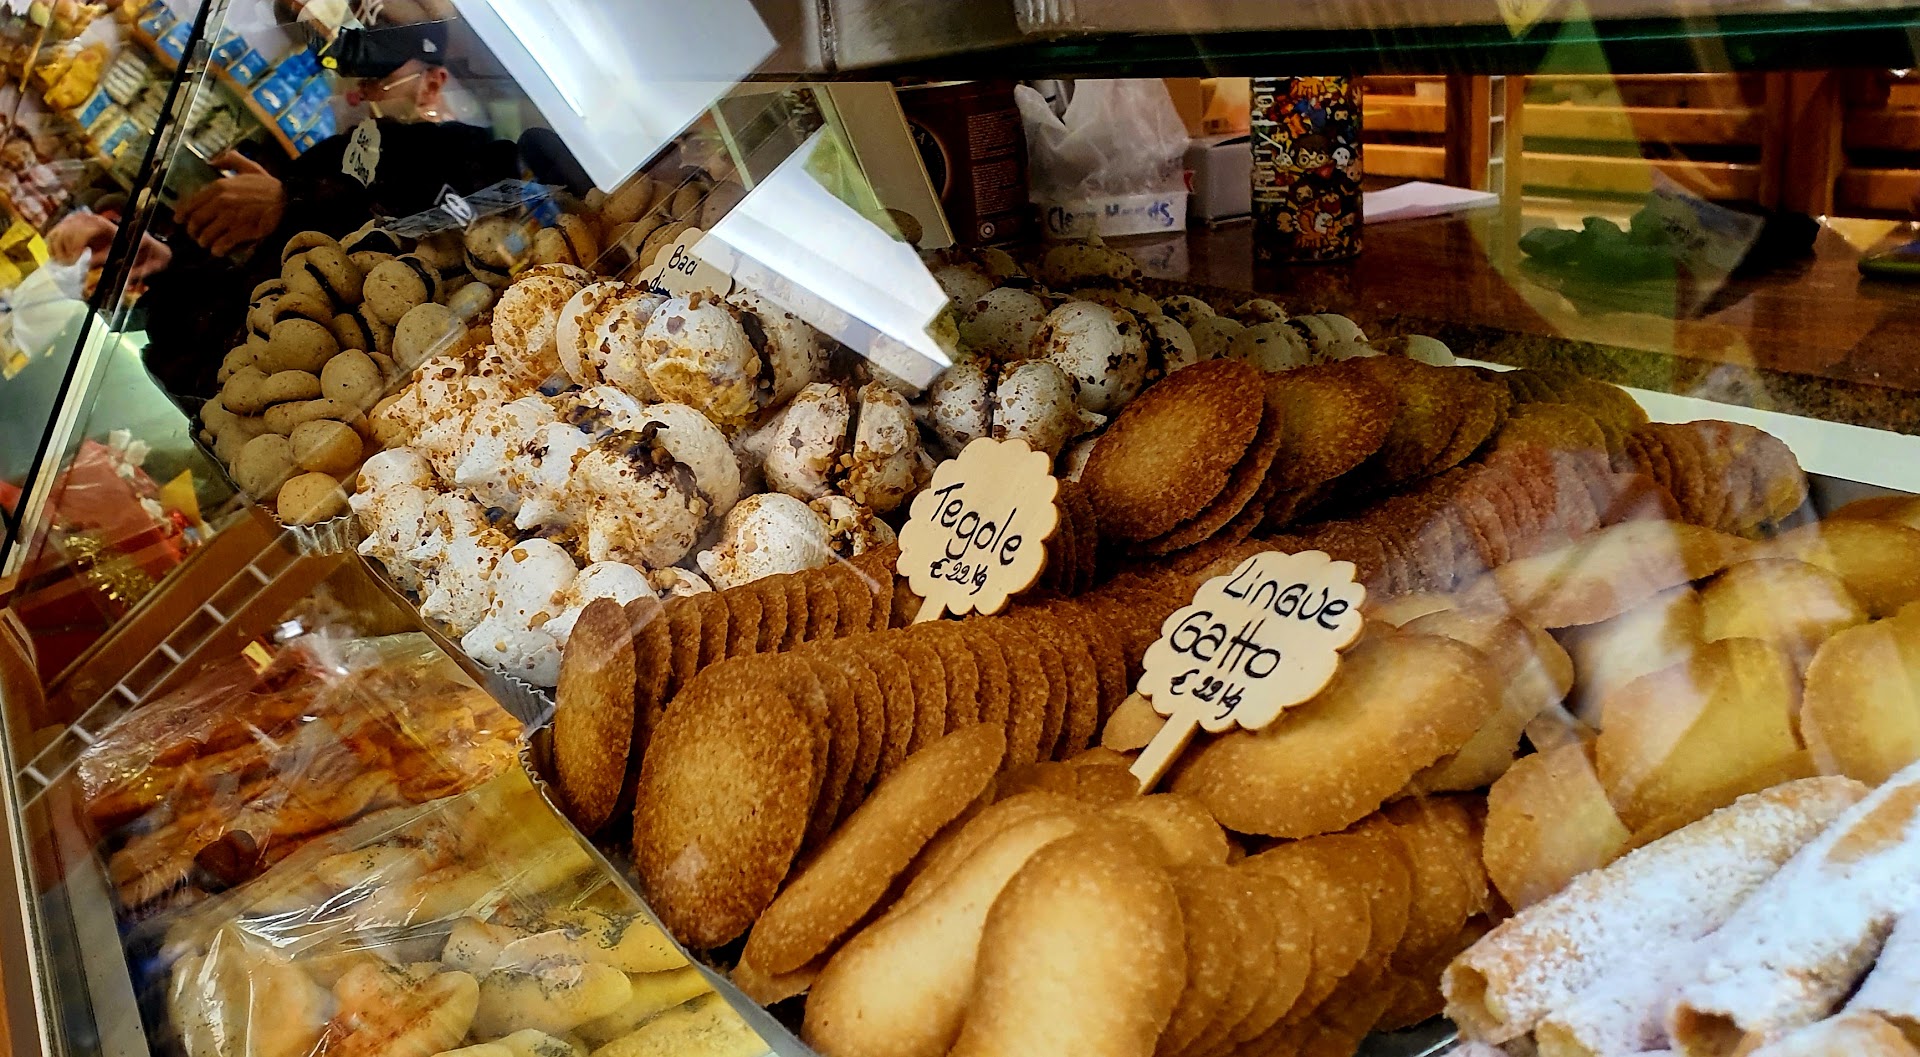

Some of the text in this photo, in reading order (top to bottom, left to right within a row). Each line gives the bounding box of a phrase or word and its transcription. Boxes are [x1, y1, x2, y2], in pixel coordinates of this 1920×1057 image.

[1049, 205, 1097, 234] Cle
[668, 244, 702, 276] Baci
[650, 267, 666, 290] di
[930, 482, 1022, 566] Tegole
[1170, 610, 1281, 679] Gatto
